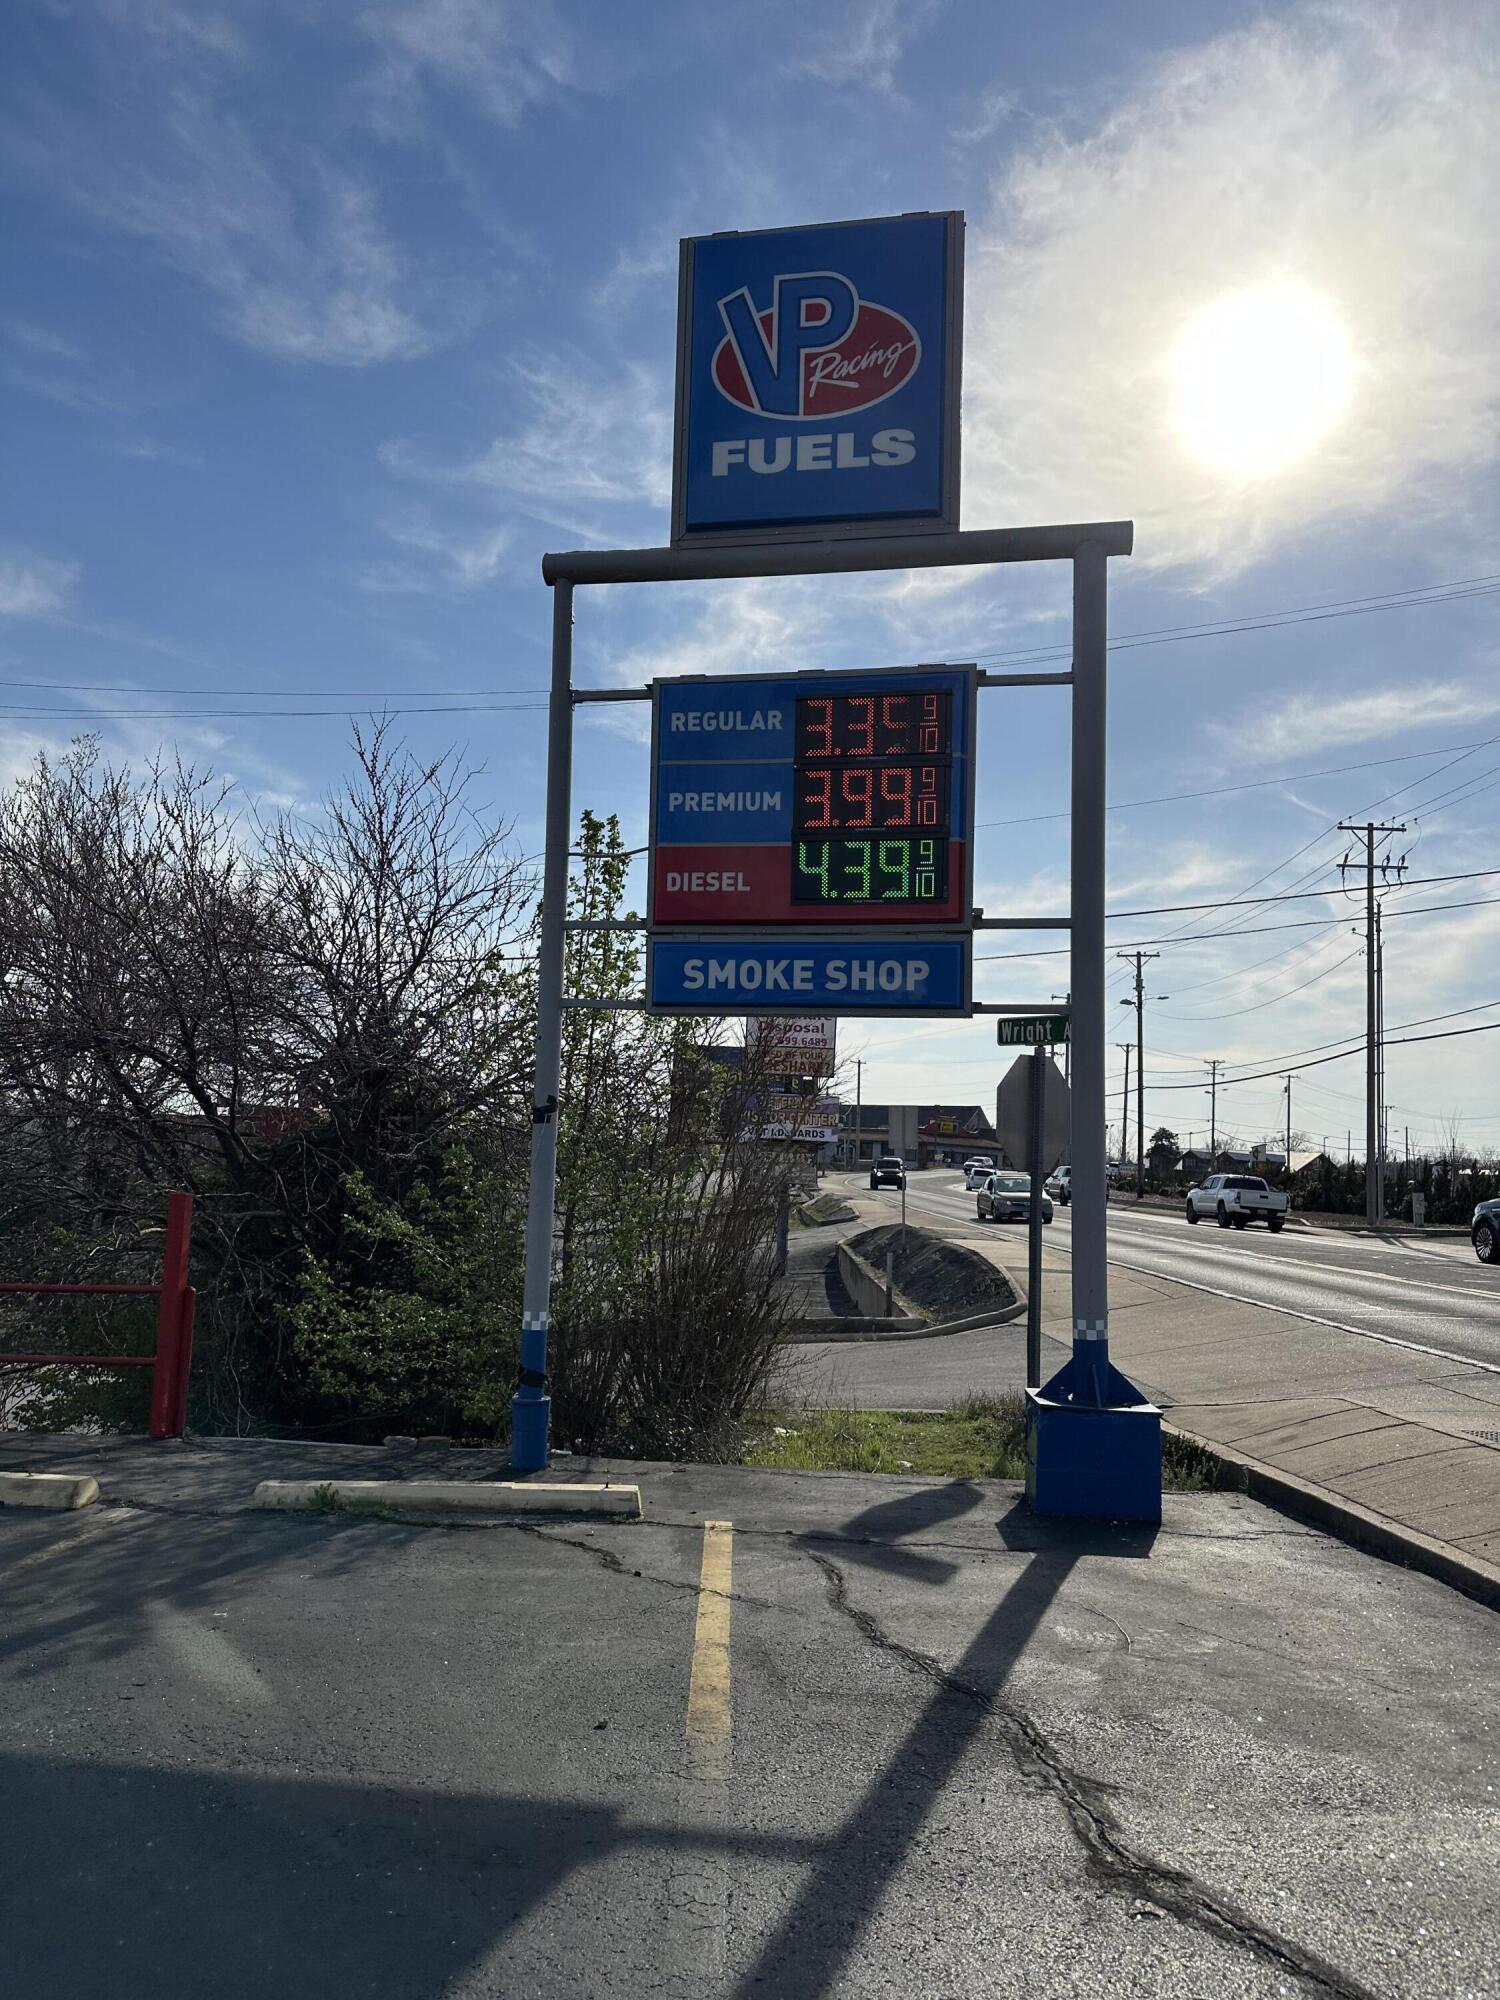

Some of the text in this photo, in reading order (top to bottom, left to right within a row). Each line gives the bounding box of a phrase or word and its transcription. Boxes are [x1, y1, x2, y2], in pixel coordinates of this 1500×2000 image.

[717, 271, 860, 420] VP
[808, 340, 914, 398] Racing
[711, 428, 917, 477] FUELS
[670, 710, 783, 732] REGULAR
[668, 791, 781, 812] PREMIUM
[803, 767, 912, 827] 3.99
[666, 872, 751, 892] DIESEL
[798, 839, 910, 898] 4.39
[682, 959, 931, 991] SMOKE SHOP
[1001, 1021, 1053, 1043] Wright
[792, 1127, 826, 1139] ARDS
